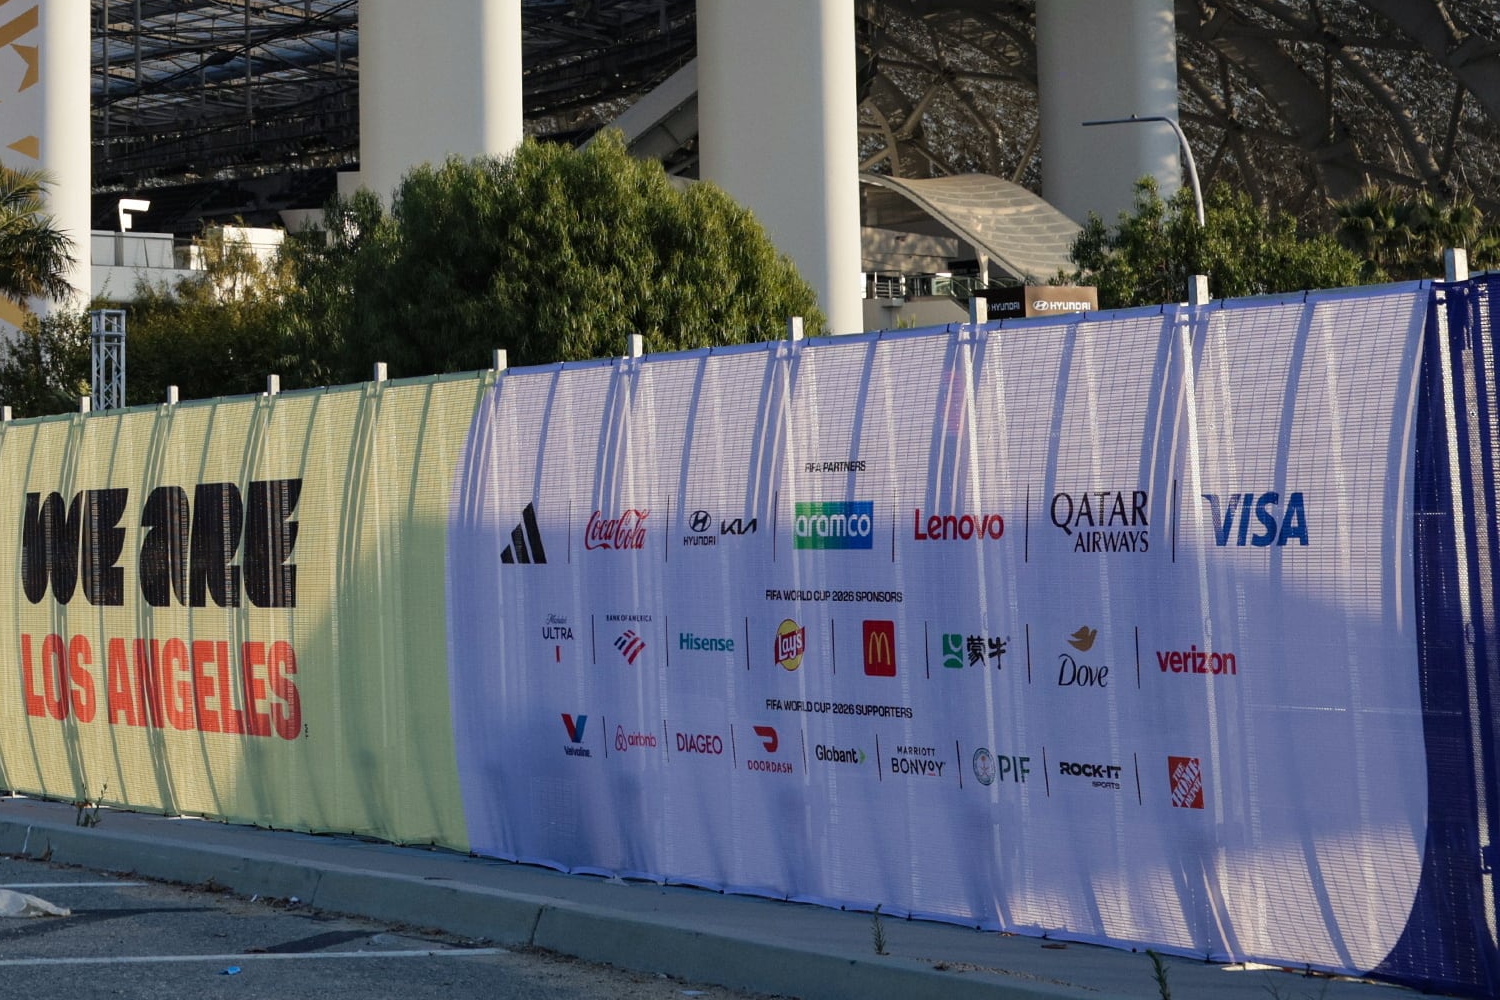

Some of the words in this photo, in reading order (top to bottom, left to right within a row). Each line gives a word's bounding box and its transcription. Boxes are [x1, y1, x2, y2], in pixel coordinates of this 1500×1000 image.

[991, 302, 1020, 311] HYUNDAI
[1050, 302, 1091, 311] HYUNDAI
[804, 462, 821, 472] FIFA
[823, 460, 866, 472] PARTNERS
[1050, 490, 1149, 536] QATAR
[1202, 492, 1309, 547] VISA
[795, 513, 871, 538] aramco
[914, 509, 1004, 541] Lenovo
[21, 487, 129, 606] WE
[139, 478, 303, 608] ARE
[683, 535, 716, 546] HYUNDAI
[1074, 531, 1149, 553] AIRWAYS
[765, 590, 782, 601] FIFA
[783, 590, 812, 601] WORLD
[813, 590, 830, 601] CUP
[832, 591, 854, 602] 2026
[855, 591, 903, 603] SPONSORS
[542, 626, 574, 640] ULTRA
[679, 633, 734, 652] Hisense
[966, 634, 1007, 670] 蒙牛
[1156, 645, 1237, 675] verizon
[1058, 653, 1109, 687] Dove
[21, 633, 96, 723] LOS
[107, 637, 302, 741] ANGELES
[766, 699, 783, 711] FIFA
[813, 702, 831, 714] CUP
[832, 704, 855, 715] 2026
[855, 704, 913, 719] SUPPORTERS
[628, 732, 657, 748] airbnb
[676, 733, 723, 755] DIAGEO
[815, 744, 859, 764] Globant
[897, 746, 936, 757] MARRIOTT
[747, 760, 793, 774] DOORDASH
[891, 758, 945, 777] BONVOY
[998, 755, 1030, 783] PIF
[1060, 762, 1121, 779] ROCK-IT
[1092, 781, 1120, 790] SPORTS
[1172, 758, 1201, 808] HOME
